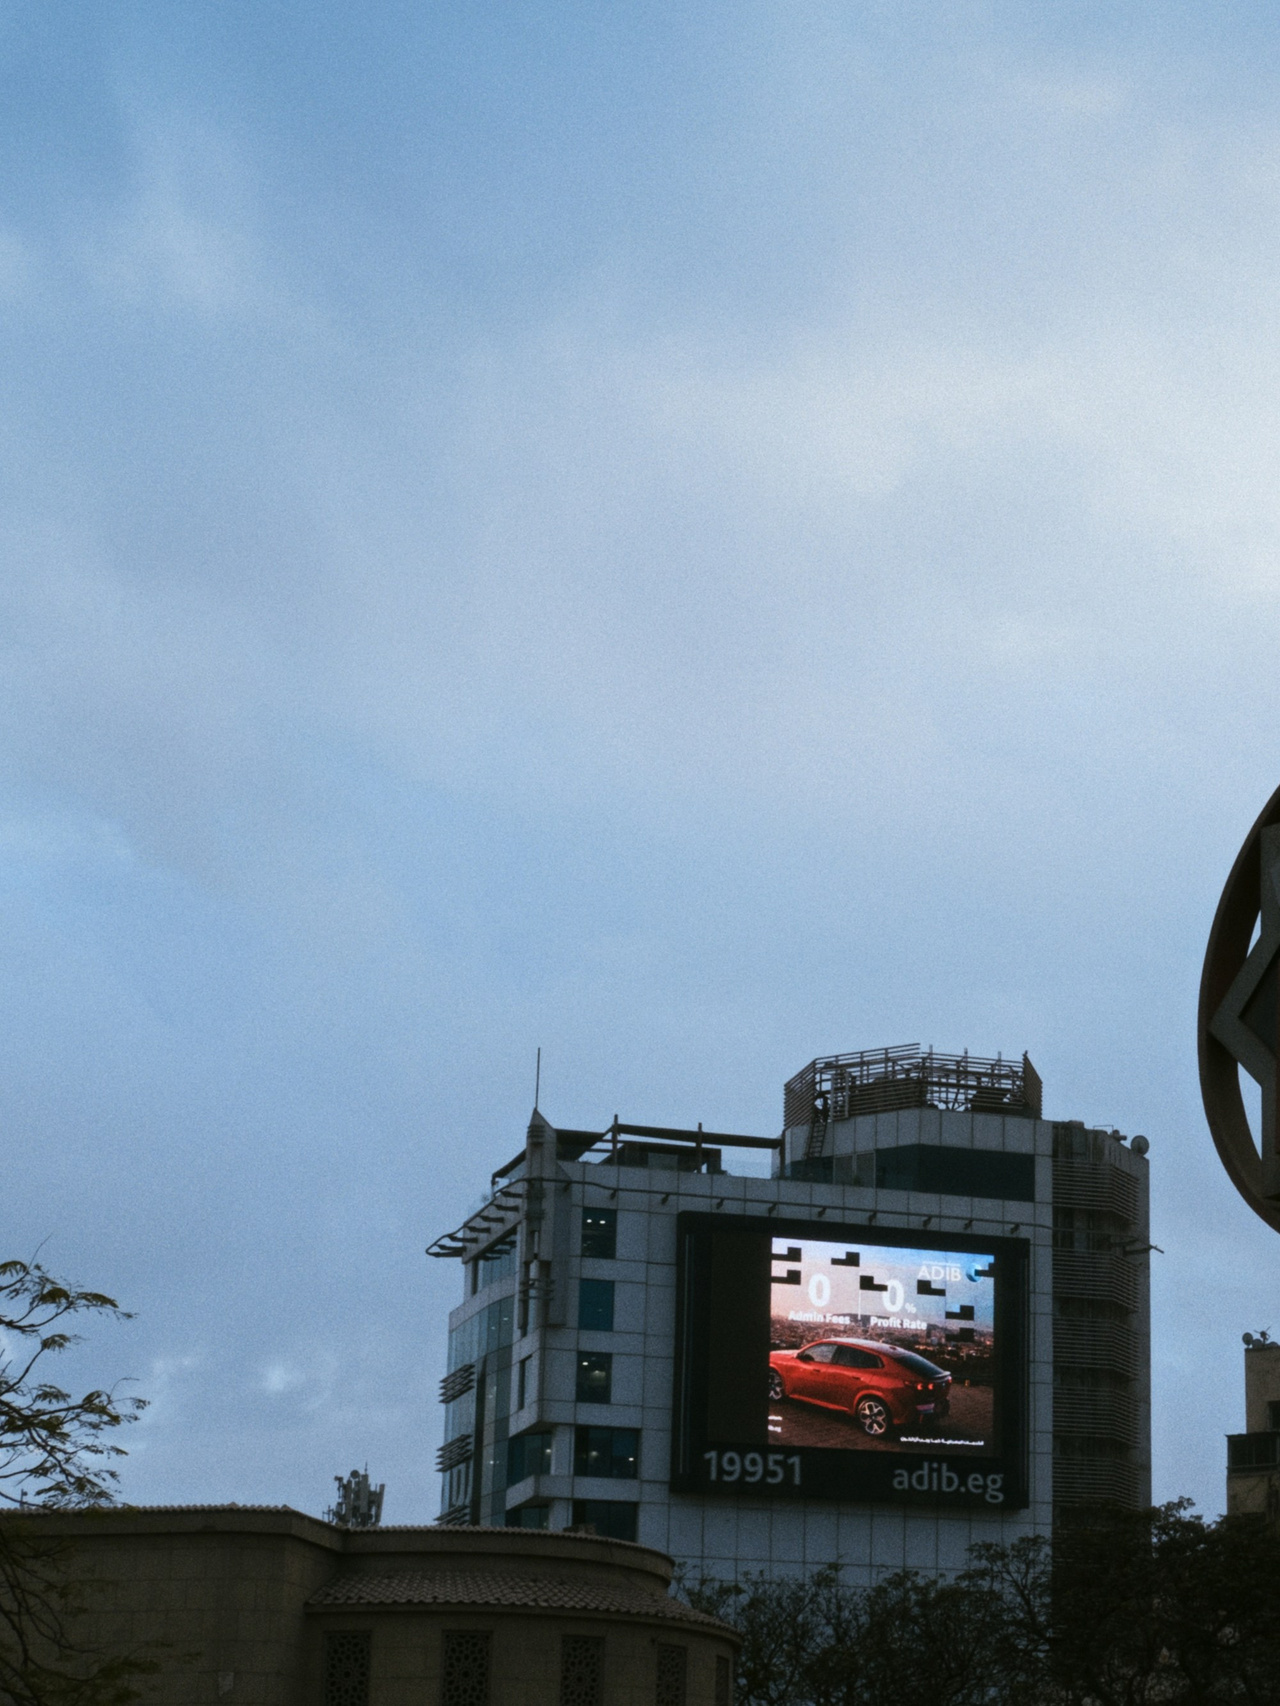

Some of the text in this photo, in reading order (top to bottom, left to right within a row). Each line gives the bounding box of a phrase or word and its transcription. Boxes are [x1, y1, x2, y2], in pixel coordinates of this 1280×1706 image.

[917, 1265, 962, 1282] ADIB
[788, 1311, 851, 1325] Admin Fees
[870, 1316, 928, 1330] Profit Rate
[704, 1450, 801, 1486] 19951
[893, 1461, 1005, 1503] adib.eg
